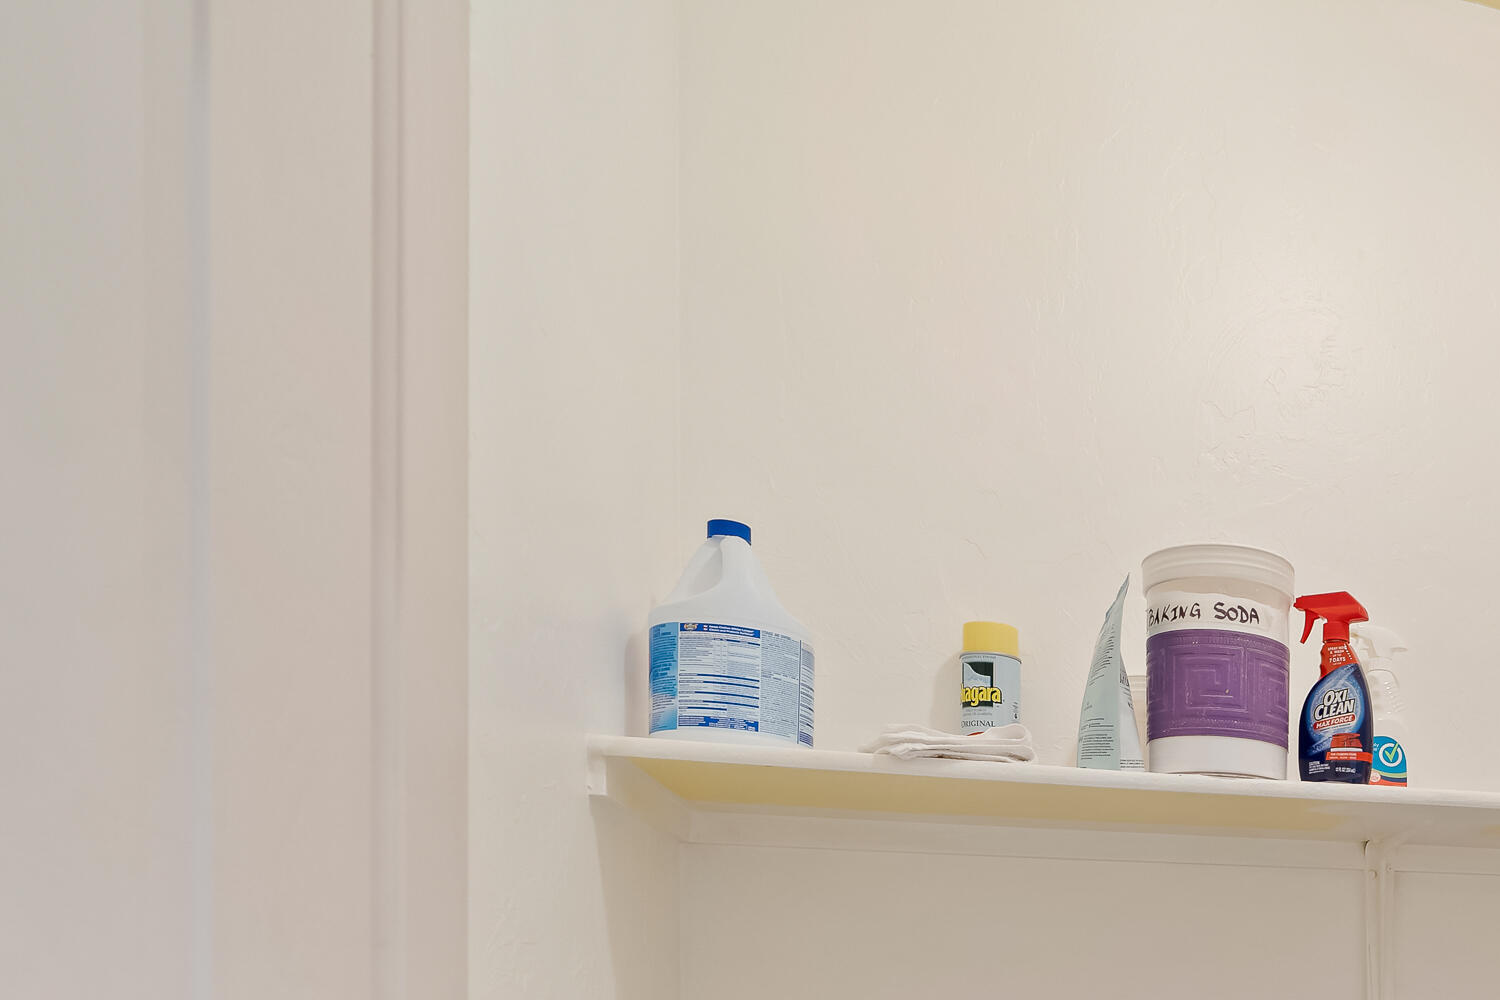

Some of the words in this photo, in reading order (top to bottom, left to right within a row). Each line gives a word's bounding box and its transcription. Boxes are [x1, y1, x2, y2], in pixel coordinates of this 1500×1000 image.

[1147, 602, 1201, 627] BAKING
[1214, 601, 1260, 624] SODA
[1323, 689, 1349, 706] OXI
[1314, 699, 1356, 721] CLEAN
[961, 720, 996, 728] ORIGINAL
[1315, 720, 1332, 729] MAX
[1331, 715, 1354, 725] FORCE
